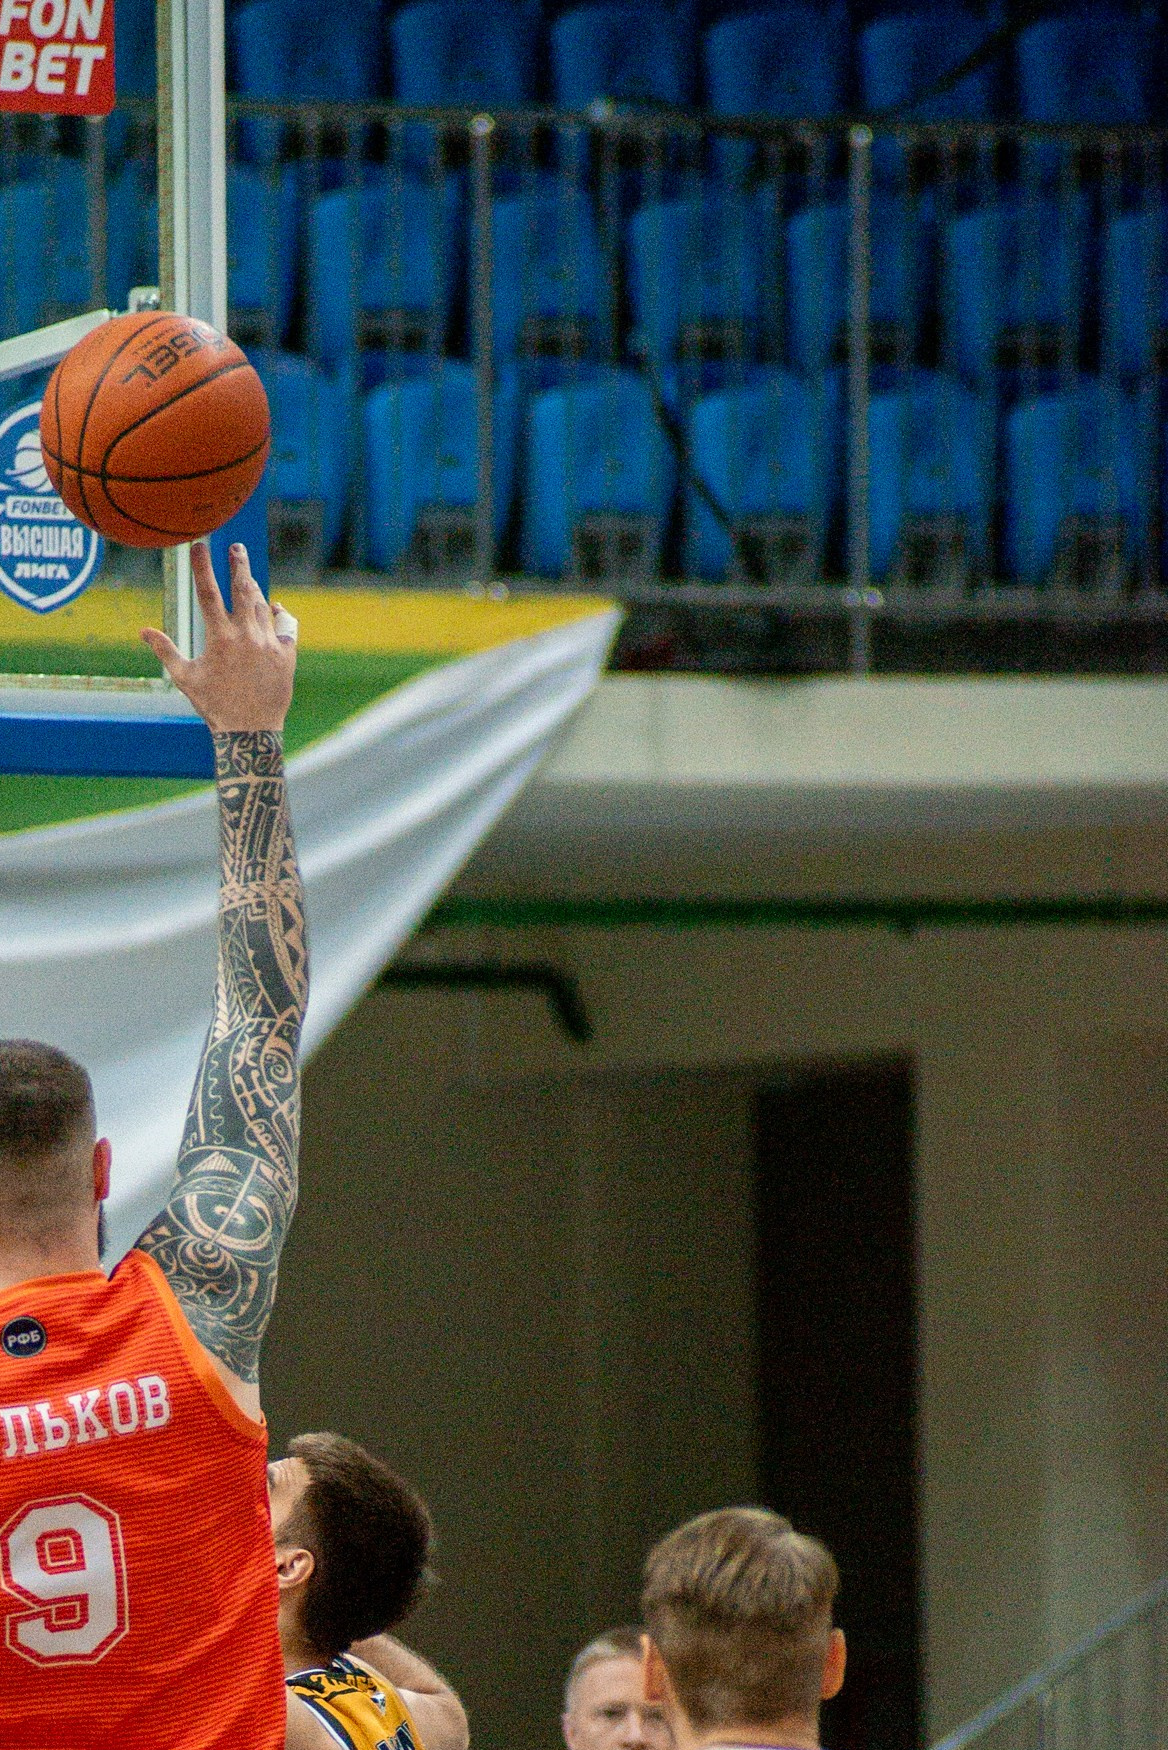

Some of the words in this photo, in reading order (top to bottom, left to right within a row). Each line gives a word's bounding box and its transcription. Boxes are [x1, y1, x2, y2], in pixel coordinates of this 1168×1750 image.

[0, 524, 84, 559] ВЫСШАЯ
[13, 562, 70, 580] ЛИГА
[7, 1329, 41, 1348] РФБ
